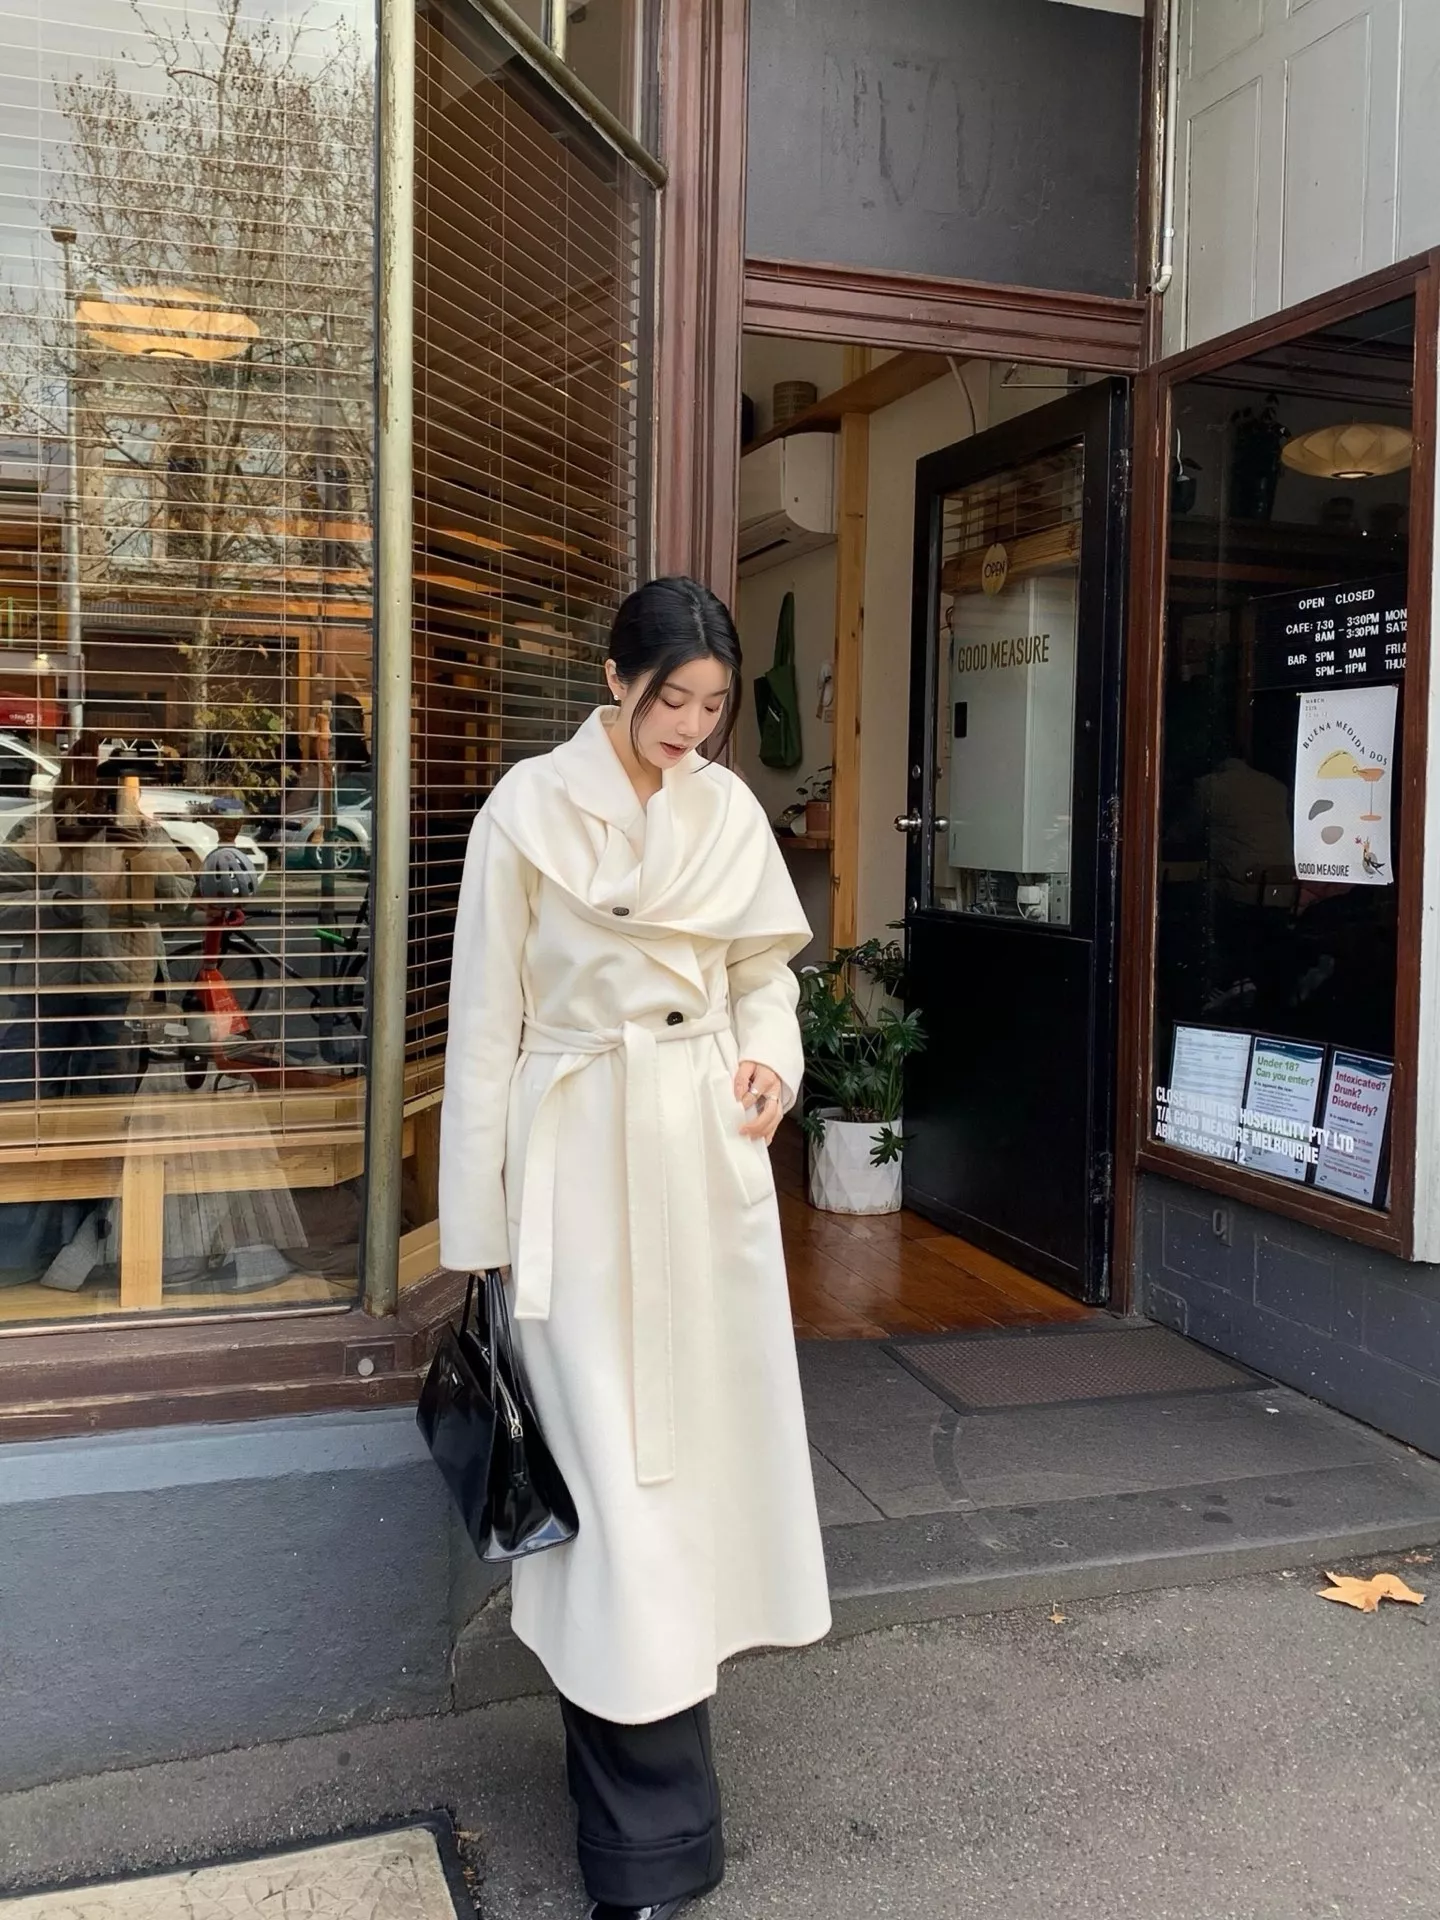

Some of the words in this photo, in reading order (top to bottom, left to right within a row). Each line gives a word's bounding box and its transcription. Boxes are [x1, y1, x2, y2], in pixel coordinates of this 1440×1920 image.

[984, 560, 1006, 578] OPEN
[1298, 596, 1325, 610] OPEN
[1335, 589, 1375, 604] CLOSED
[1285, 622, 1313, 635] CAFE:
[1346, 612, 1380, 627] 3:30PM
[1385, 607, 1407, 621] MON
[1314, 630, 1335, 643] 8AM
[1346, 624, 1379, 639] 3:30PM
[957, 643, 988, 673] GOOD
[990, 634, 1050, 670] MEASURE
[1315, 651, 1335, 663] 5PM
[1348, 647, 1366, 659] 1AM
[1315, 665, 1335, 677] 5PM
[1345, 662, 1367, 674] 11PM
[1302, 722, 1331, 749] BUENA
[1335, 720, 1365, 755] MEDIDA
[1369, 751, 1388, 766] DOS
[1298, 862, 1315, 875] GOOD
[1316, 863, 1350, 877] MEASURE
[1257, 1055, 1283, 1069] Under
[1285, 1060, 1300, 1072] 18?
[1255, 1068, 1271, 1078] Can
[1272, 1072, 1286, 1082] you
[1287, 1075, 1315, 1087] enter?
[1335, 1070, 1387, 1092] Intoxicated?
[1333, 1083, 1362, 1099] Drunk?
[1331, 1094, 1378, 1117] Disorderly?
[1155, 1086, 1185, 1107] CLOSE
[1186, 1093, 1237, 1121] QUARTERS
[1239, 1107, 1306, 1140] HOSPITALITY
[1309, 1125, 1331, 1147] PTY
[1333, 1132, 1355, 1153] LTD
[1155, 1121, 1178, 1141] ABN:
[1155, 1105, 1172, 1123] T/A
[1174, 1110, 1199, 1130] GOOD
[1201, 1116, 1249, 1145] MEASURE
[1251, 1131, 1320, 1165] MELBOURNE
